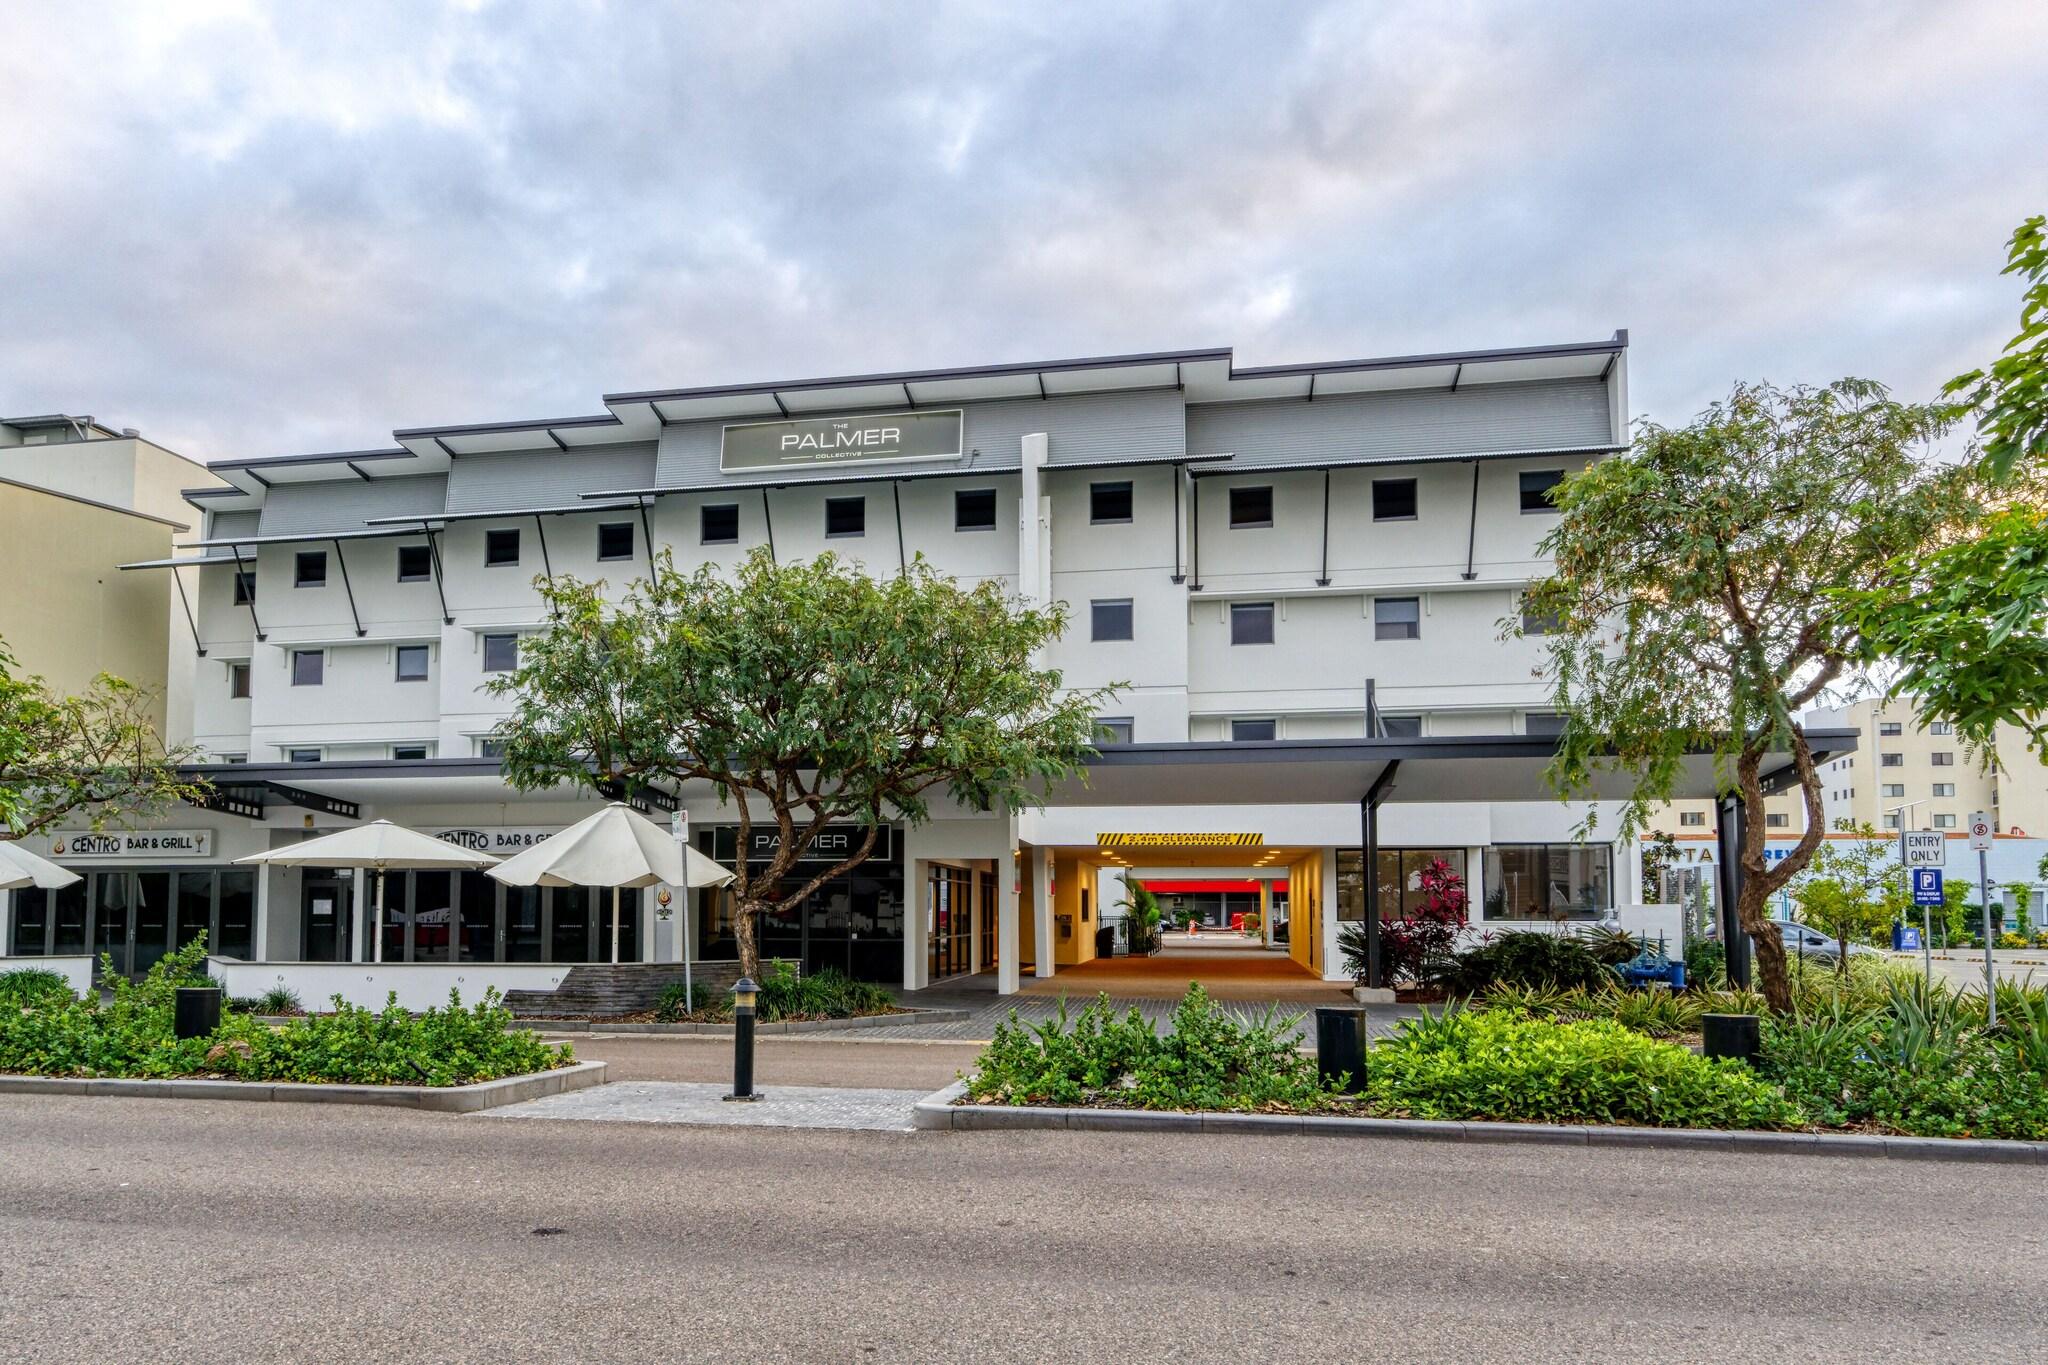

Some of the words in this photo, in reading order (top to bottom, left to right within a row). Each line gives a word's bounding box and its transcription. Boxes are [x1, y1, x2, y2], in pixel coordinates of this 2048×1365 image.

[781, 428, 900, 451] PALMER
[72, 836, 120, 852] CENTRO
[127, 838, 149, 849] BAR
[151, 838, 158, 849] &
[161, 837, 192, 849] GRILL
[496, 834, 521, 846] BAR
[524, 834, 532, 846] &
[755, 834, 848, 849] PAMER
[1908, 836, 1940, 847] ENTRY
[1911, 850, 1940, 861] ONLY
[1922, 874, 1932, 887] P
